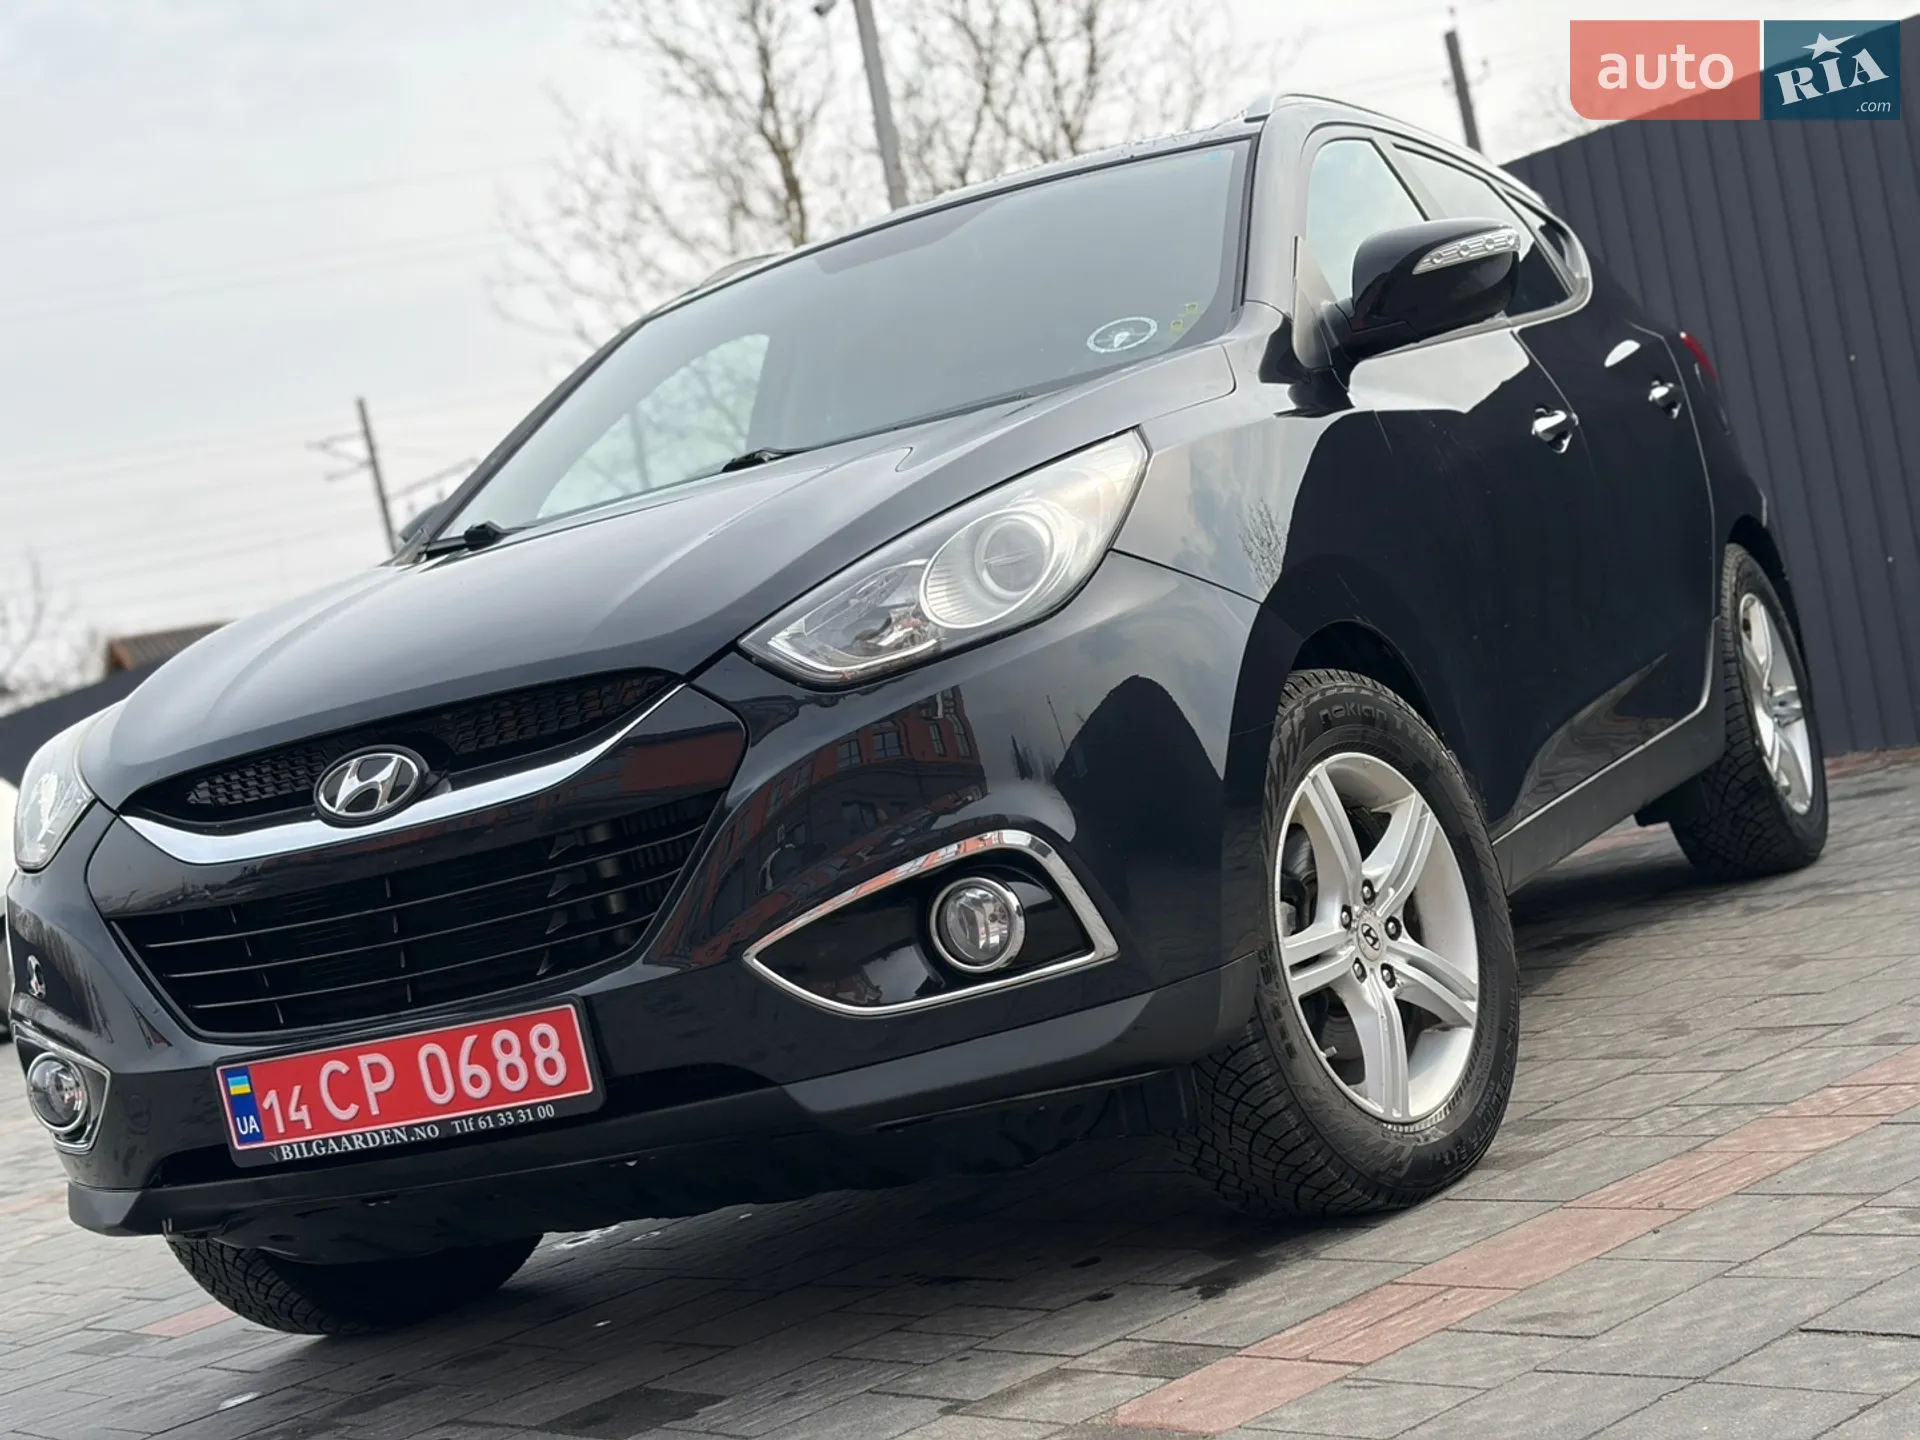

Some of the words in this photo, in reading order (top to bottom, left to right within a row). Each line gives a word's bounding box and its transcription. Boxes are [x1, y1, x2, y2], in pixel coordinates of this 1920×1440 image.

[262, 1085, 313, 1134] 14
[318, 1053, 396, 1121] CP
[417, 1023, 567, 1106] 0688
[236, 1115, 261, 1135] UA
[280, 1124, 440, 1162] BILGAARDEN.NO
[452, 1118, 475, 1134] Tlf
[477, 1115, 494, 1130] 61
[497, 1112, 515, 1127] 33
[518, 1108, 535, 1124] 31
[538, 1104, 555, 1119] 00
